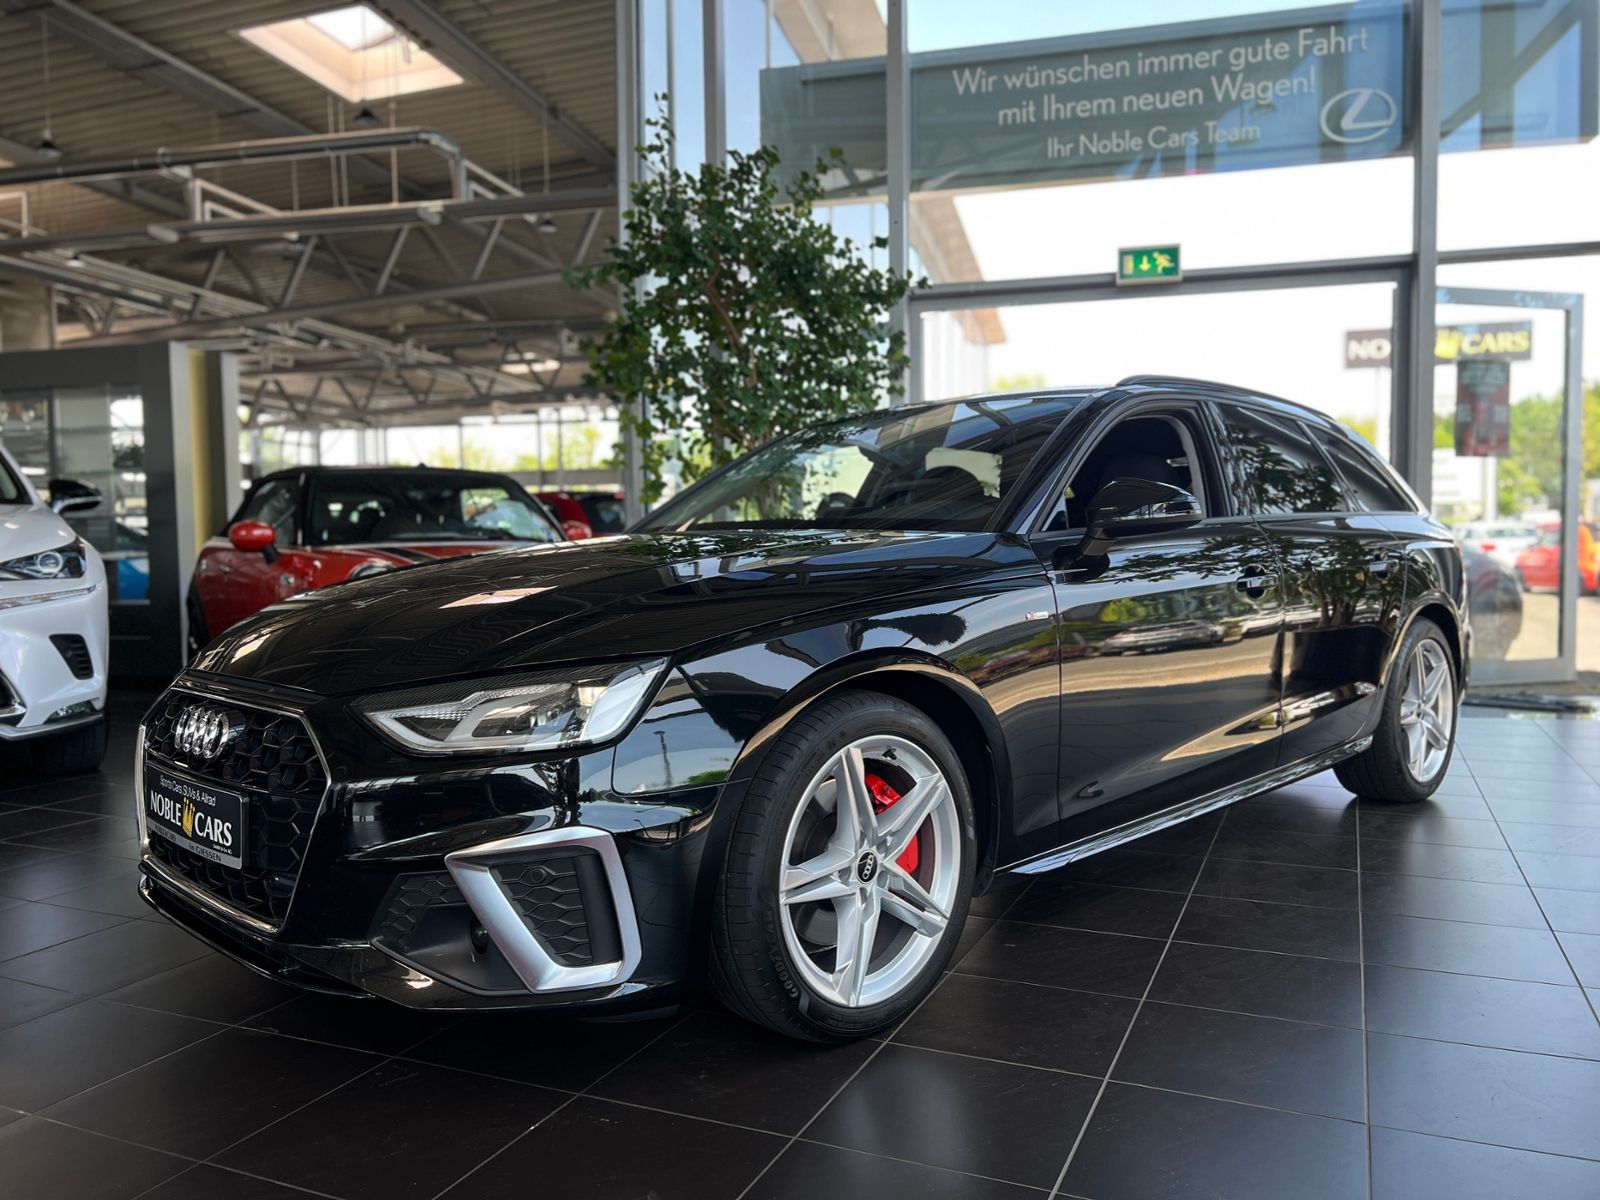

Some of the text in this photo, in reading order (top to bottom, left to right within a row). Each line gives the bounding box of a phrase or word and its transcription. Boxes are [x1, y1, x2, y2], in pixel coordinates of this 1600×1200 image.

[952, 26, 1369, 96] Wir wünschen immer gute Fahrt
[998, 66, 1316, 126] mit Ihrem neuen Wagen!
[1047, 120, 1261, 159] Ihr Noble Cars Team
[1461, 331, 1529, 354] CARS
[150, 790, 182, 826] NOBLE
[194, 812, 233, 847] CARS
[196, 845, 222, 863] GIESSEN
